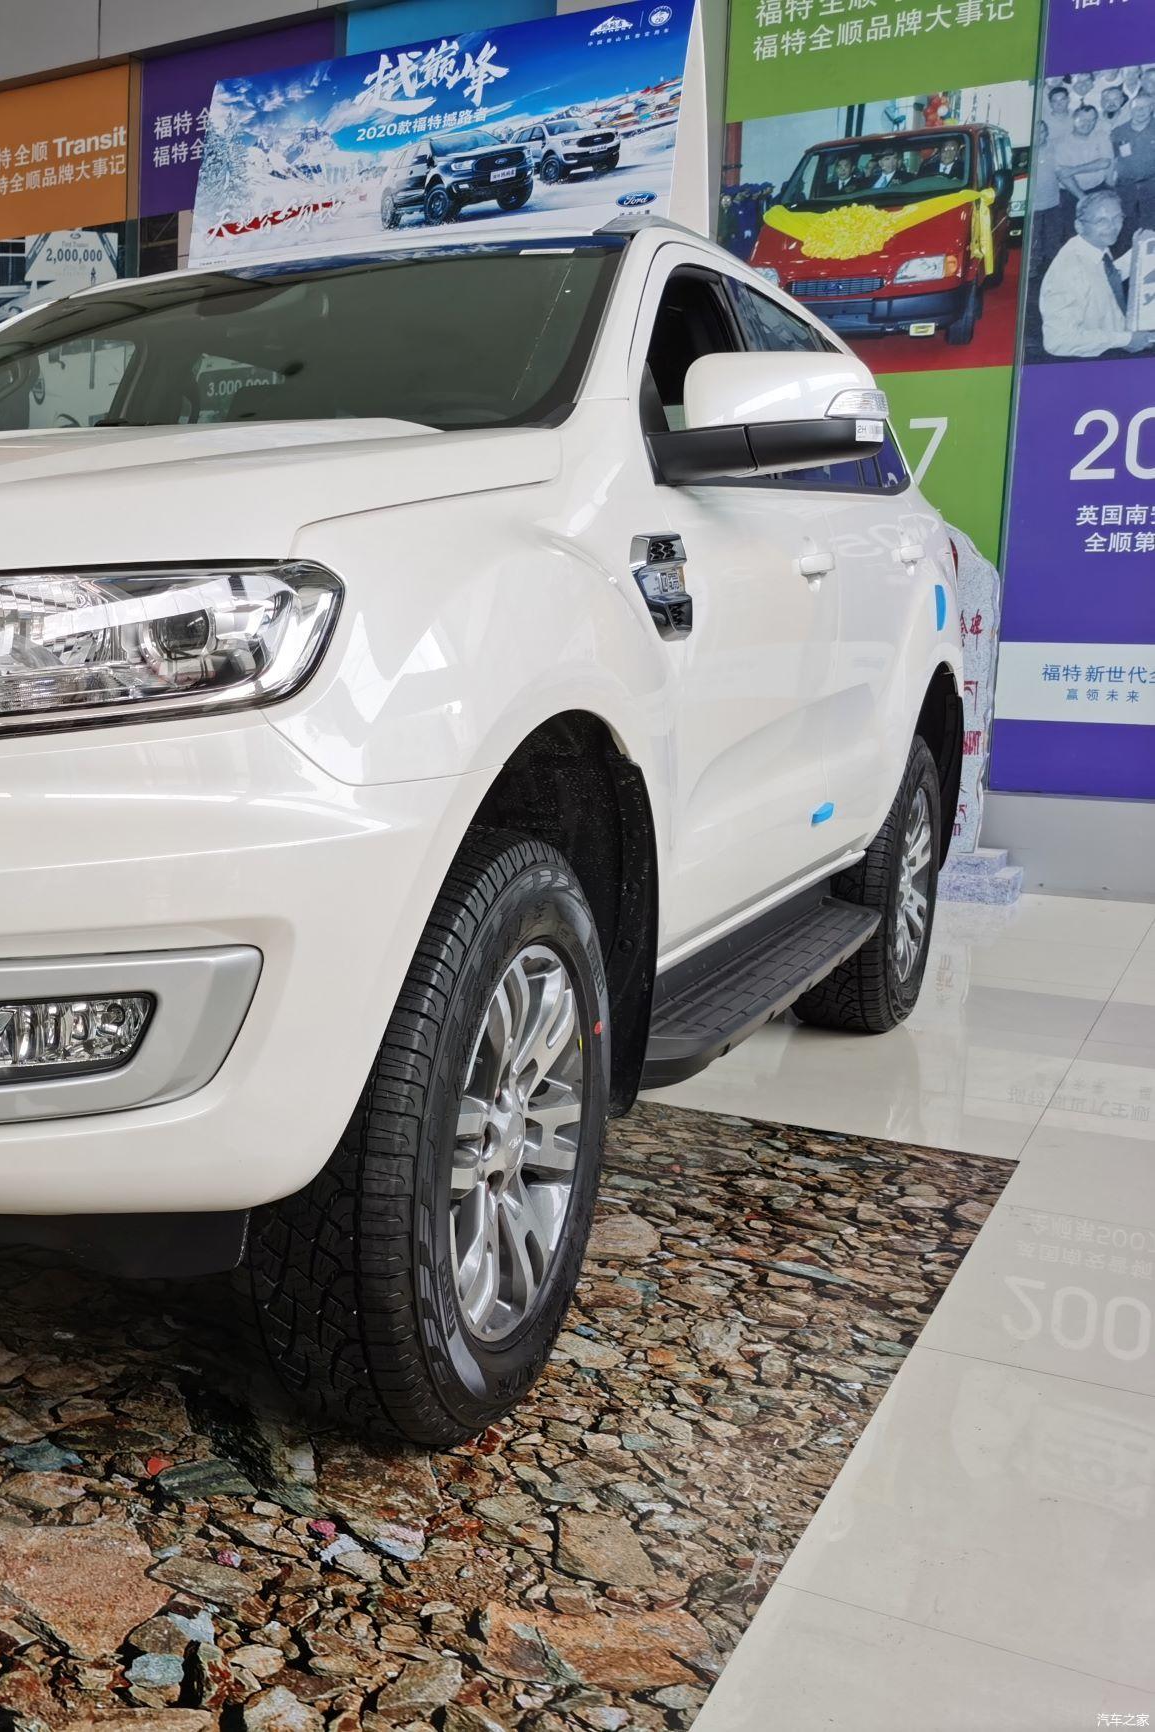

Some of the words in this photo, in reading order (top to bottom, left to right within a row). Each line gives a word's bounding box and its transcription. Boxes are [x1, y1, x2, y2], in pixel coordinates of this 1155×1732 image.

[752, 0, 1016, 62] 福特全顺品牌大事记
[352, 39, 510, 116] 越巅峰
[356, 106, 489, 142] 2020款福特撼路者
[52, 125, 127, 158] Transit
[623, 192, 649, 206] Ford
[46, 247, 103, 265] 2,000,000
[1075, 503, 1155, 526] 英国南
[1066, 688, 1140, 704] 赢领未来
